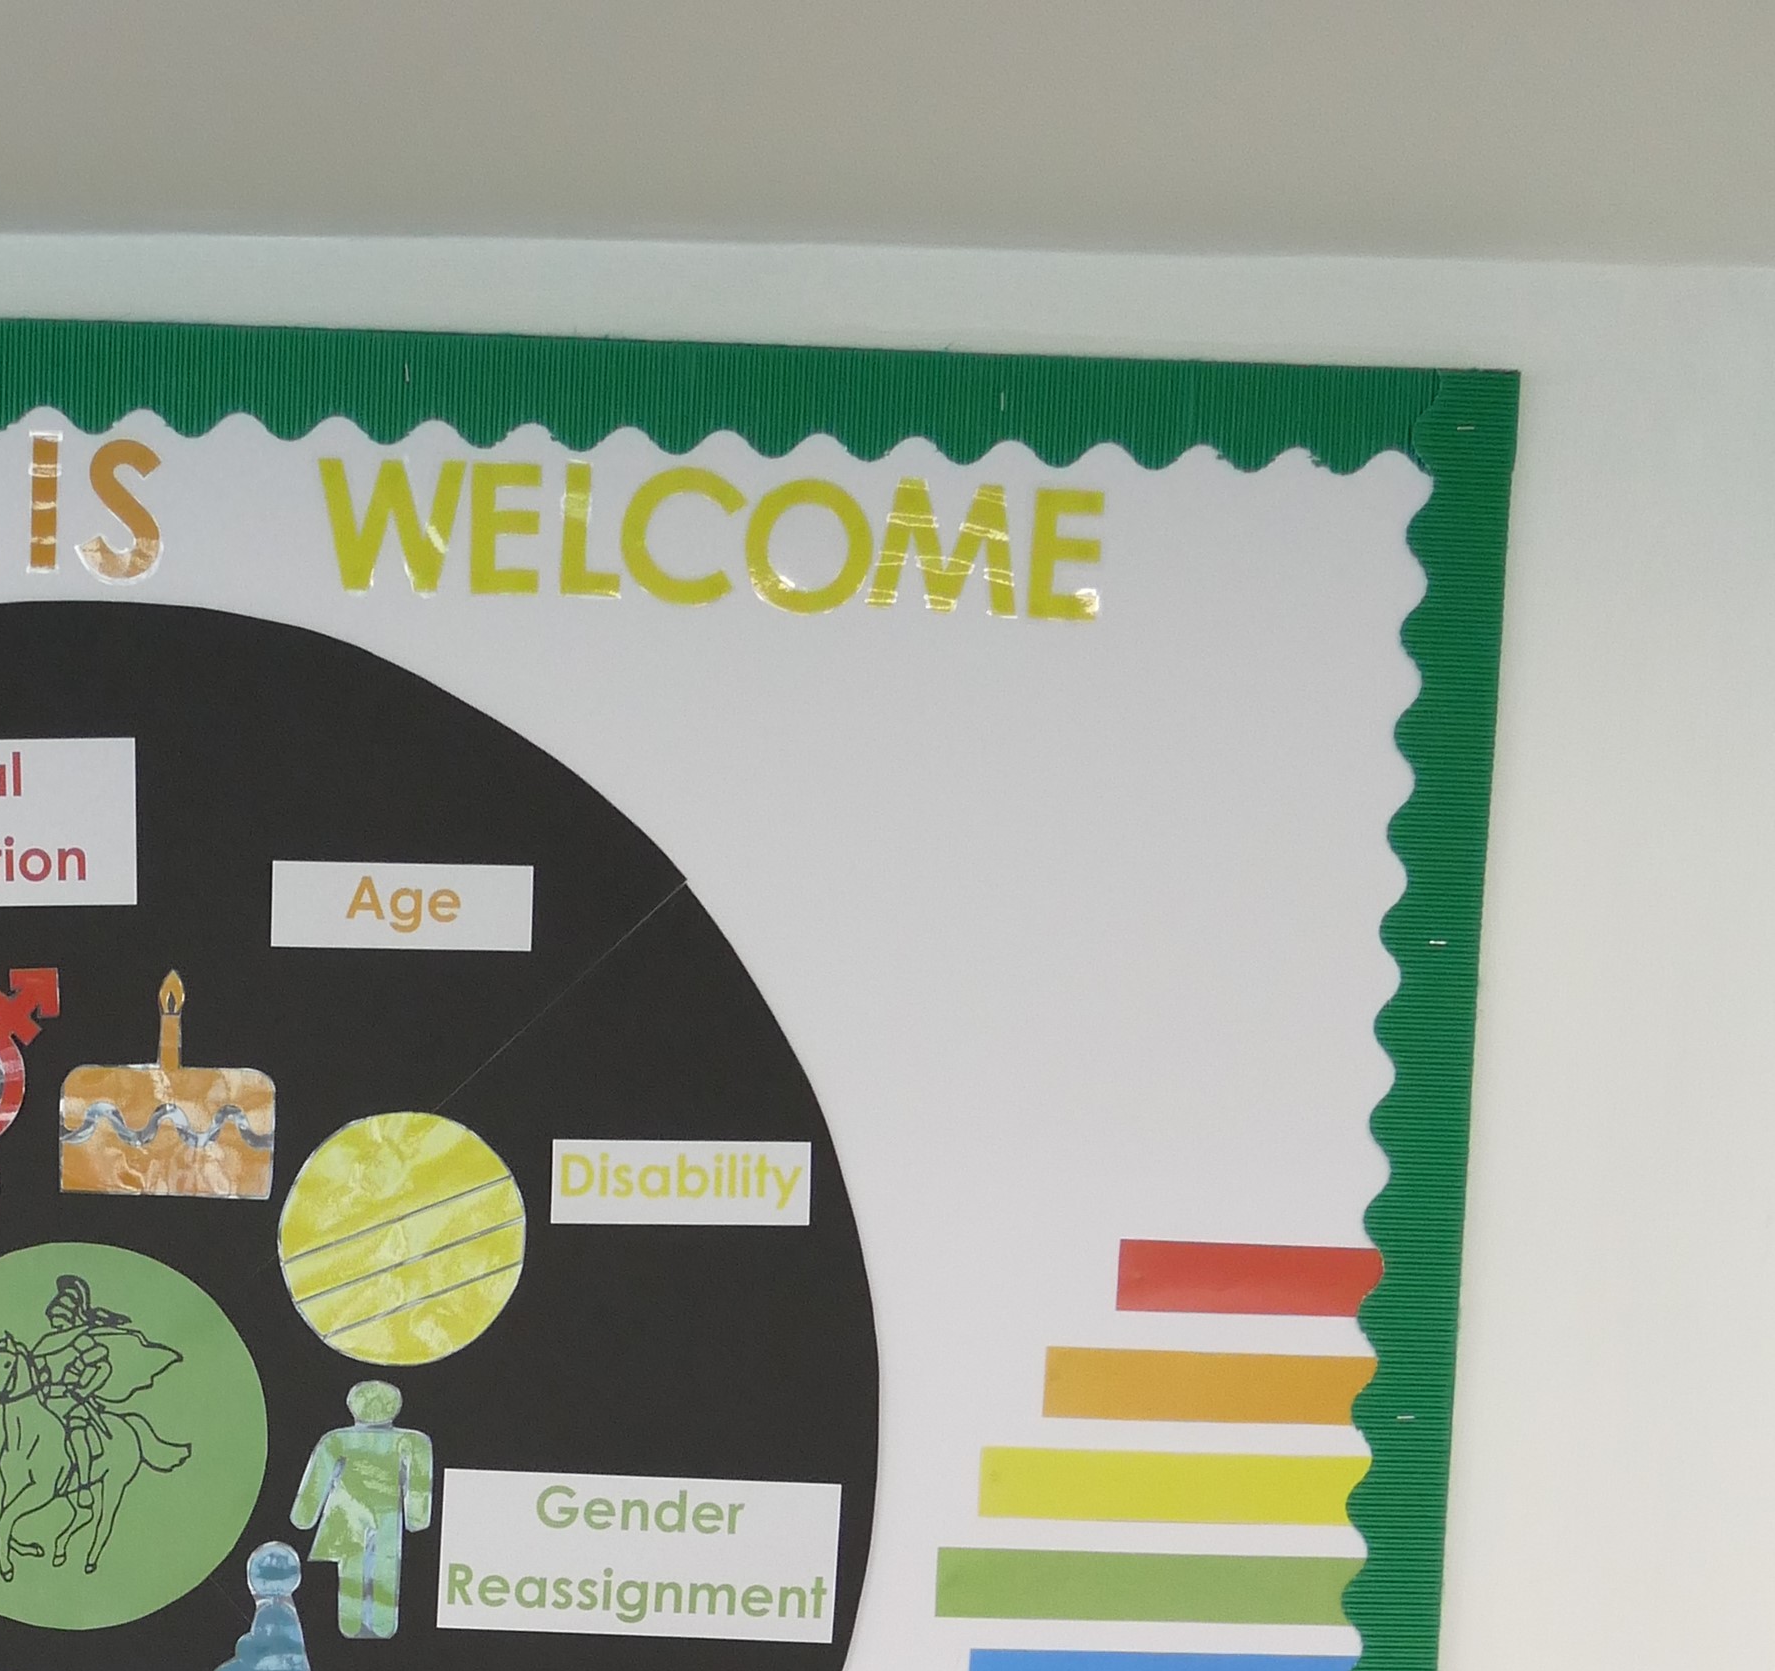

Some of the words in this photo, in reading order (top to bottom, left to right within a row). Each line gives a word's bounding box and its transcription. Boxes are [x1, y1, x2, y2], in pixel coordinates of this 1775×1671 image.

[28, 433, 163, 580] IS
[318, 457, 1105, 622] WELCOME
[345, 874, 462, 934] Age
[558, 1152, 804, 1212] Disability
[535, 1483, 746, 1535] Gender
[447, 1562, 827, 1623] Reassignment
